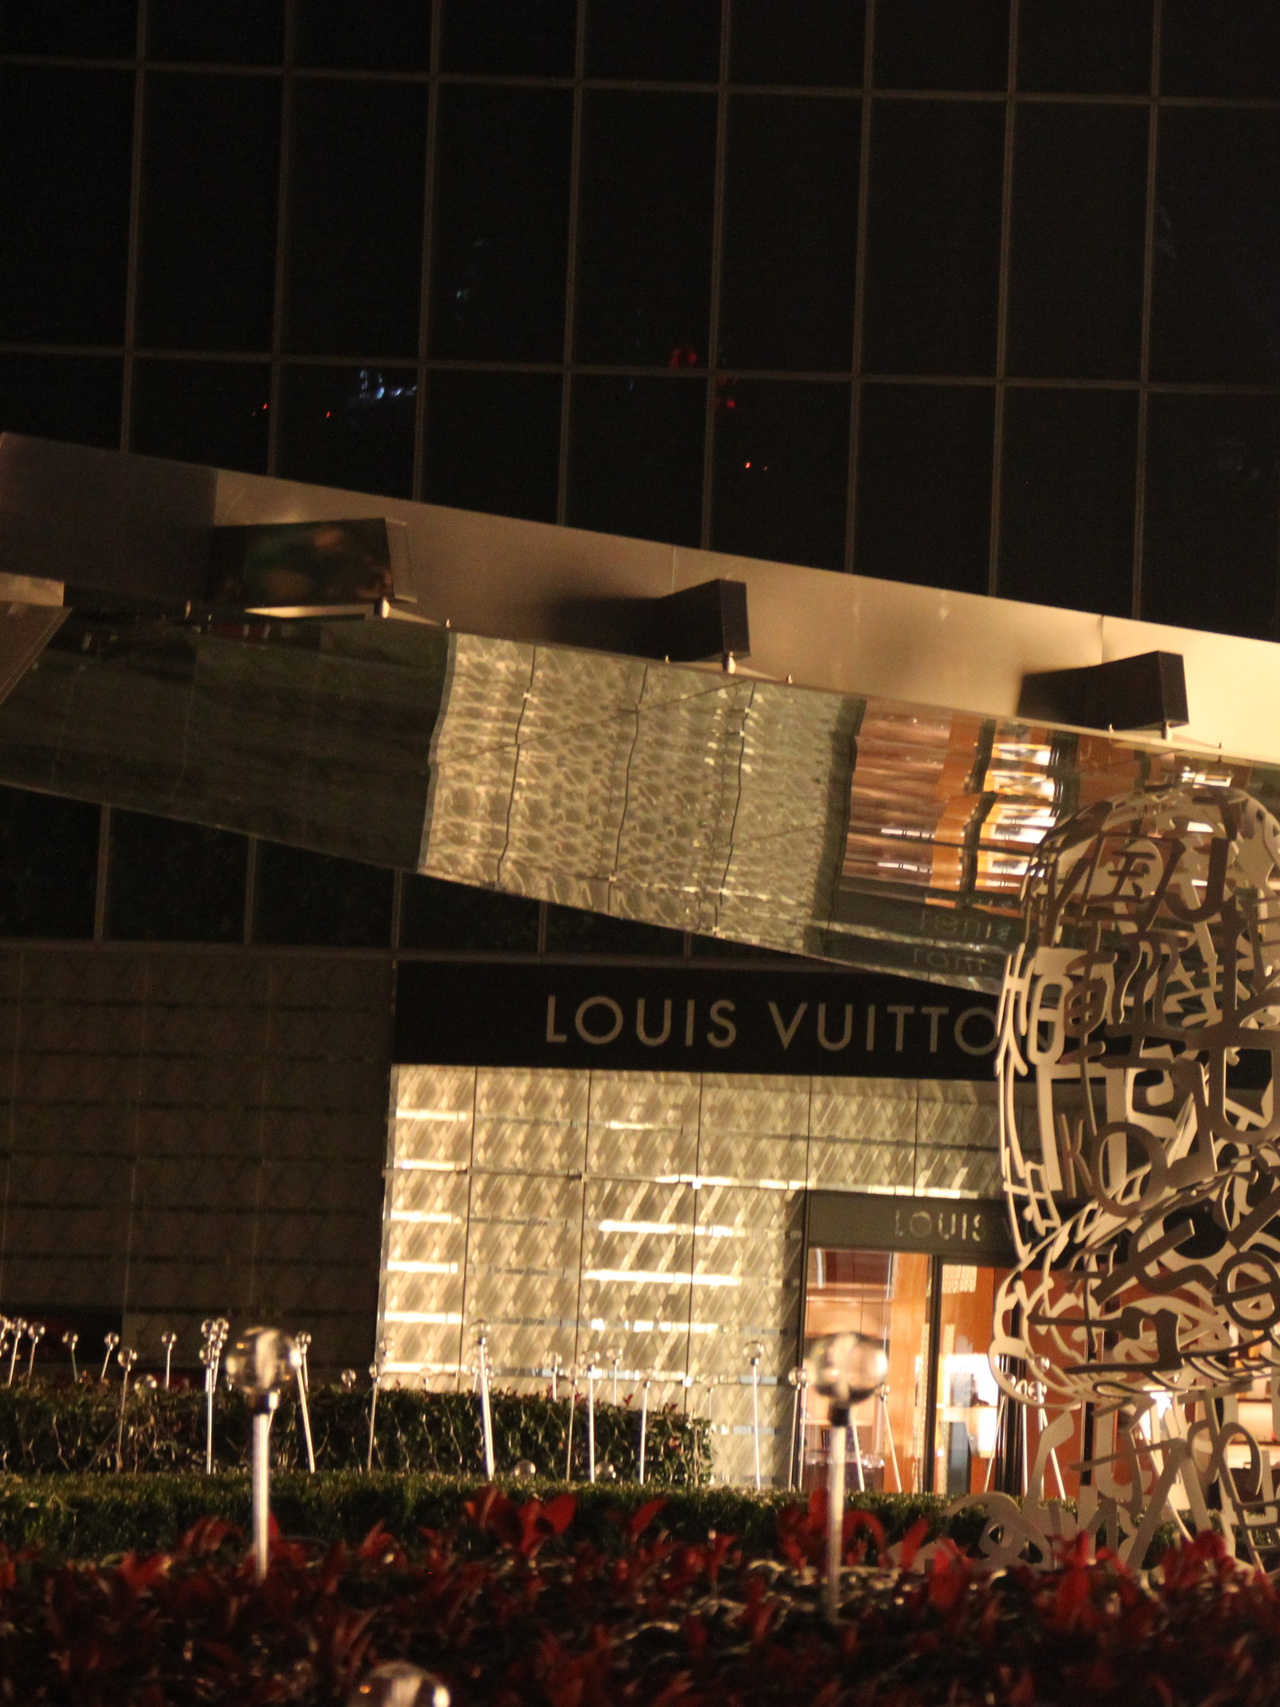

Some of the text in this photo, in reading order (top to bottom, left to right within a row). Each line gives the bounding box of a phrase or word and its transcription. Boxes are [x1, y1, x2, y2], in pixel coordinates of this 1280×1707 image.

[545, 996, 1054, 1056] LOUIS VUITTO
[893, 1208, 982, 1243] LOUIS
